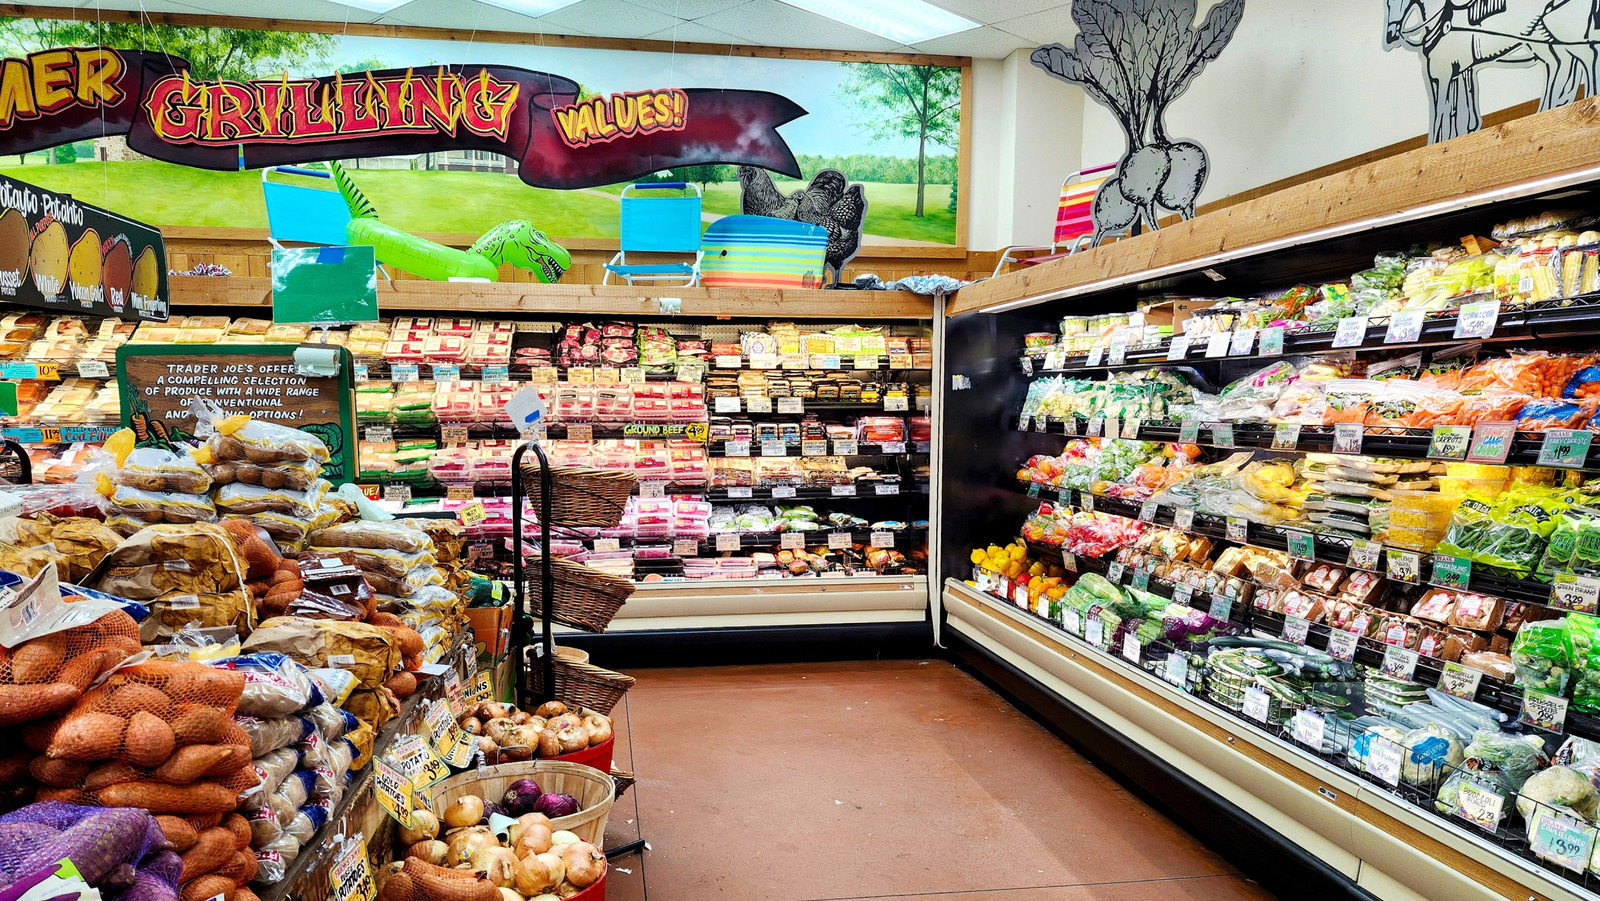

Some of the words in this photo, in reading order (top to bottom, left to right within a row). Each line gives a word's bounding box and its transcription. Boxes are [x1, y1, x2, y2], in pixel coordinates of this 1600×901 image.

[147, 67, 519, 144] GRILLING
[553, 90, 686, 144] VALUES!
[0, 180, 38, 217] otayto
[42, 193, 83, 226] Potahto
[35, 273, 60, 294] White
[69, 280, 90, 300] Yukon
[110, 287, 124, 306] Red
[167, 364, 218, 374] TRADER
[222, 364, 254, 374] JOE'S
[157, 376, 165, 385] A
[167, 375, 240, 386] COMPELLING
[243, 376, 307, 387] SELECTION
[145, 387, 160, 396] OF
[164, 387, 212, 397] PRODUCE
[216, 387, 241, 397] WITH
[245, 387, 254, 396] A
[255, 387, 281, 397] WIDE
[285, 388, 319, 397] RANGE
[180, 398, 193, 407] OF
[165, 410, 190, 419] AND
[250, 409, 304, 420] OPTIONS!
[65, 432, 87, 442] Cod
[624, 425, 660, 435] GROUND
[662, 425, 684, 435] BEEF
[1436, 436, 1463, 444] CARROTS
[363, 486, 379, 499] UE!
[1451, 564, 1467, 572] BEANS
[1575, 587, 1596, 596] BEANS
[462, 681, 488, 699] NINS
[401, 751, 430, 774] POTATO
[381, 773, 399, 790] GOLD
[376, 776, 406, 806] POTATOES
[1463, 787, 1496, 807] BROCCOLI
[1541, 824, 1586, 847] CAULIFLOWER
[337, 859, 365, 899] POTATOES
